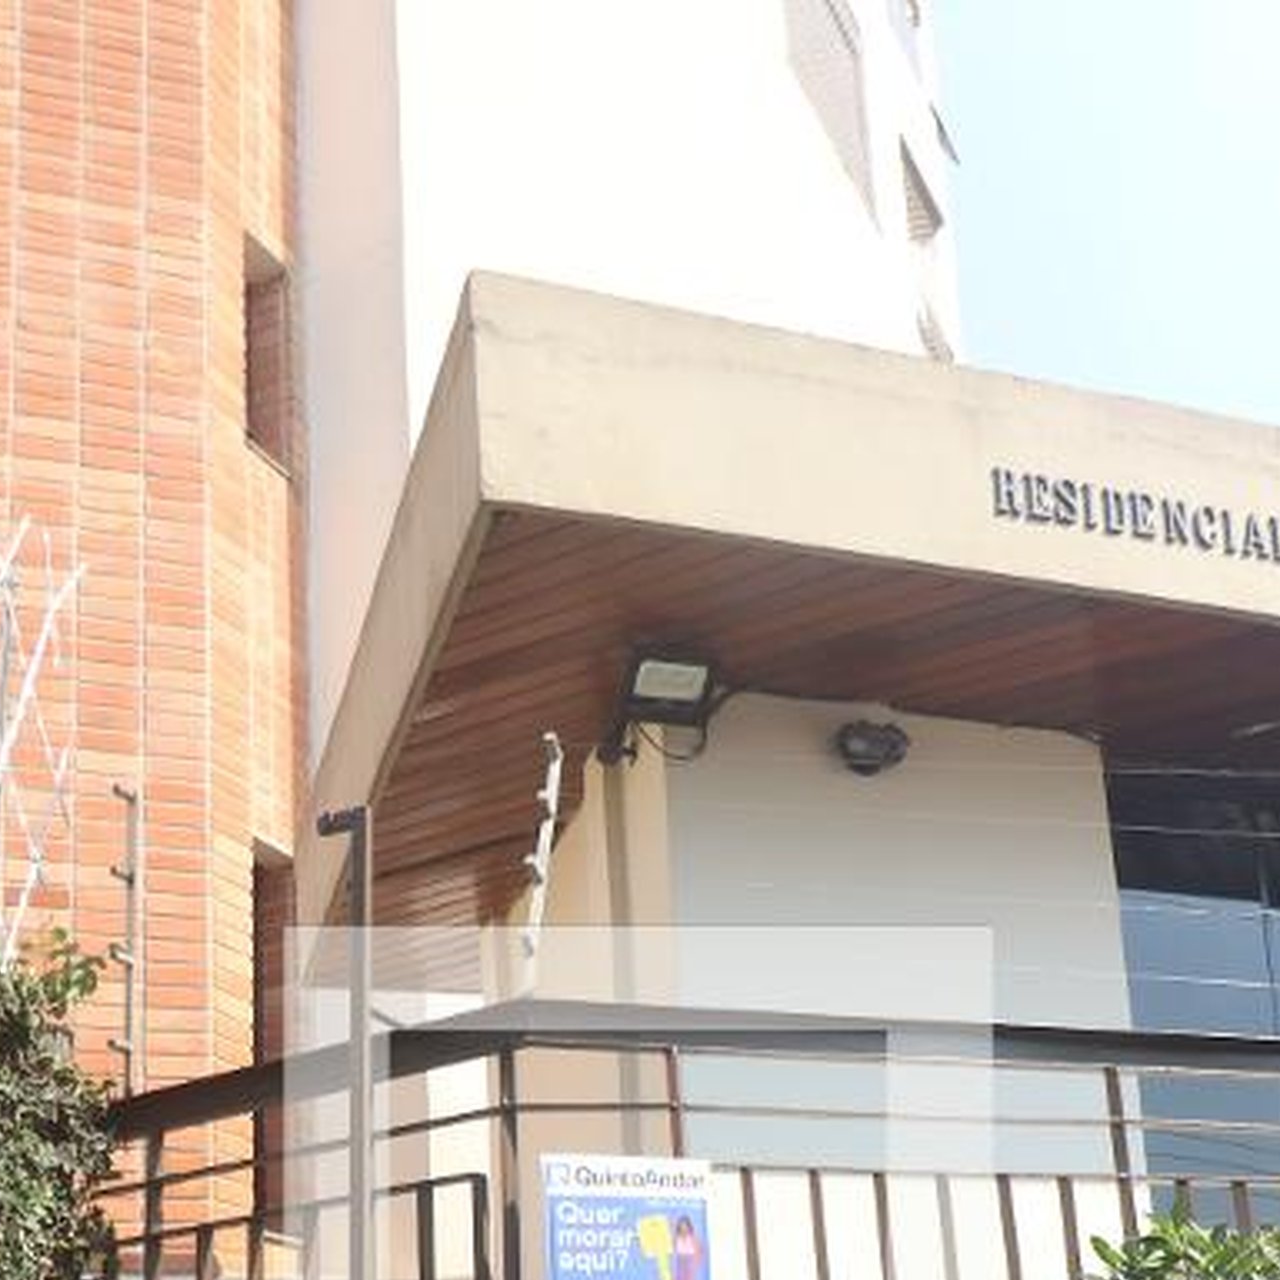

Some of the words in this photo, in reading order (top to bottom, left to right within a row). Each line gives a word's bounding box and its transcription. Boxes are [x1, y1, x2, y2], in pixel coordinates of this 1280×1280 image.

[575, 1165, 705, 1190] QuintoAndar
[558, 1200, 624, 1226] Quer
[559, 1228, 638, 1249] morar
[559, 1250, 628, 1276] aqui?
